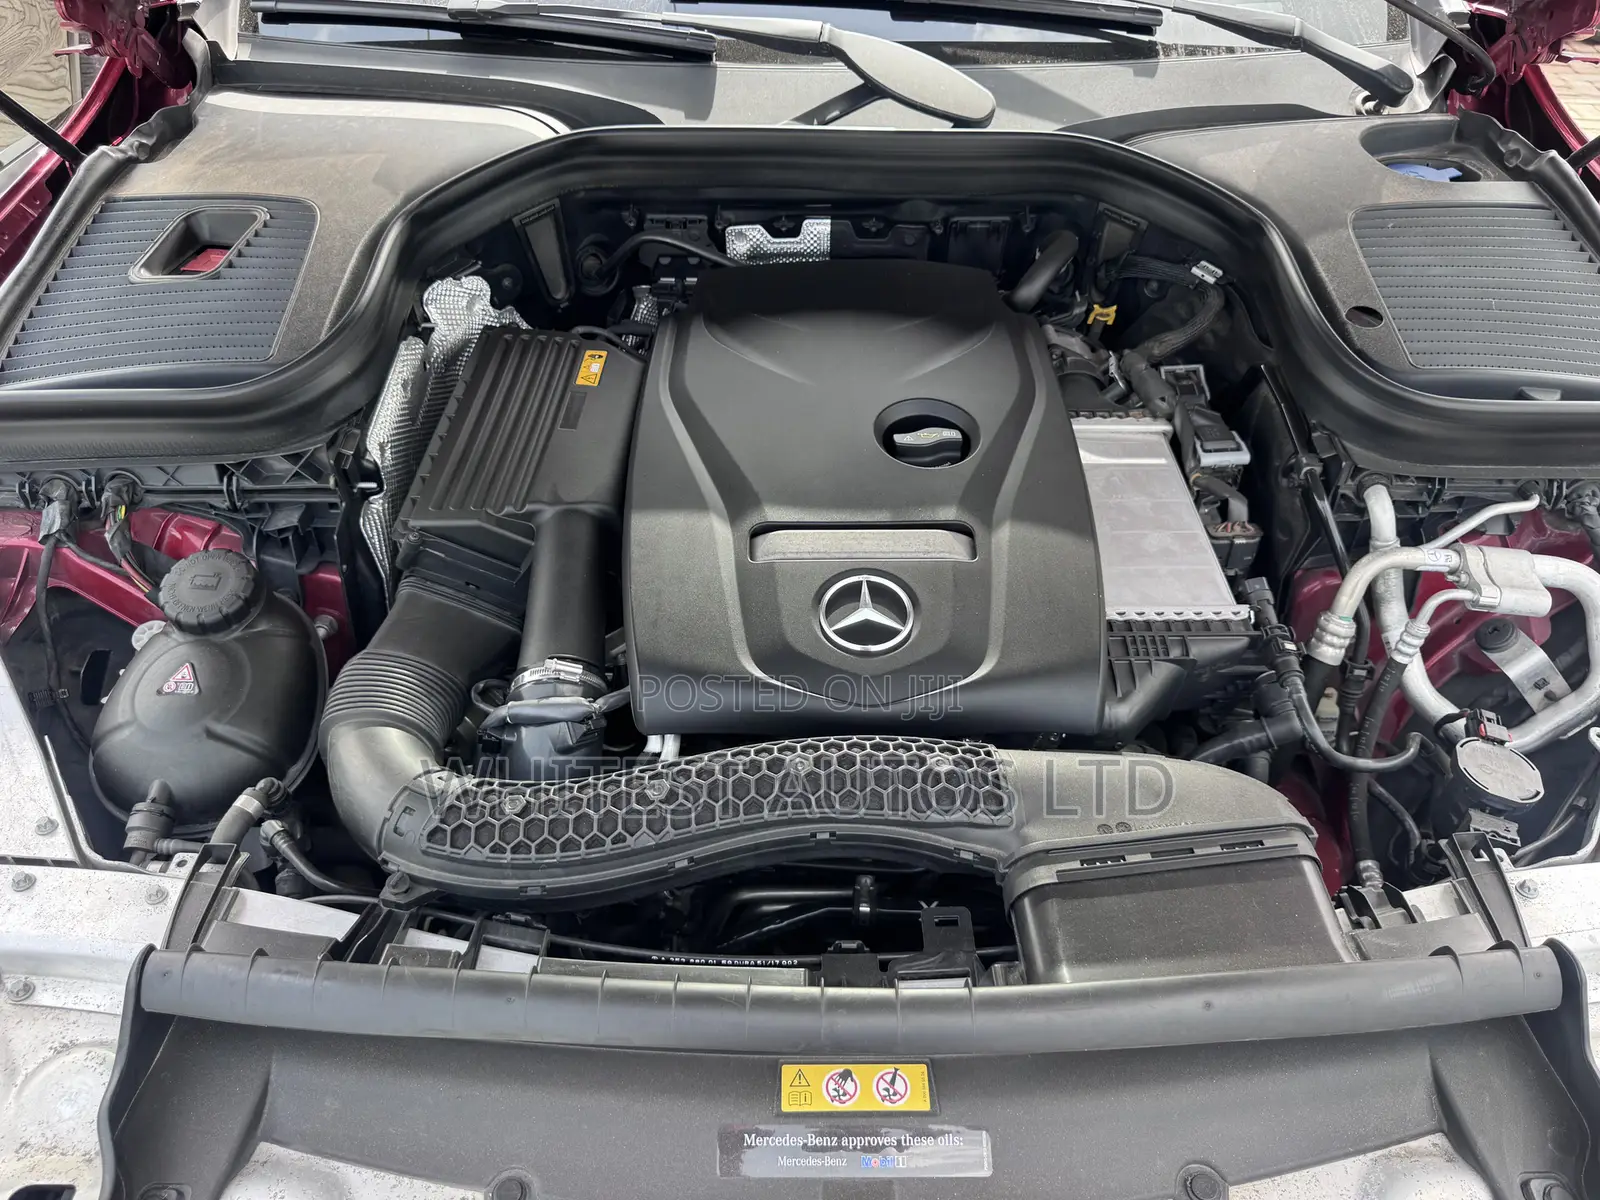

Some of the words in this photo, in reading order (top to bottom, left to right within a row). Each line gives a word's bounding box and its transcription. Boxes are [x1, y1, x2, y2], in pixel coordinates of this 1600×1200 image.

[743, 1133, 838, 1147] Mercedes-Benz
[841, 1136, 897, 1149] approves
[901, 1134, 935, 1147] these
[937, 1133, 964, 1147] oils:
[777, 1155, 847, 1168] Mercedes-Benz
